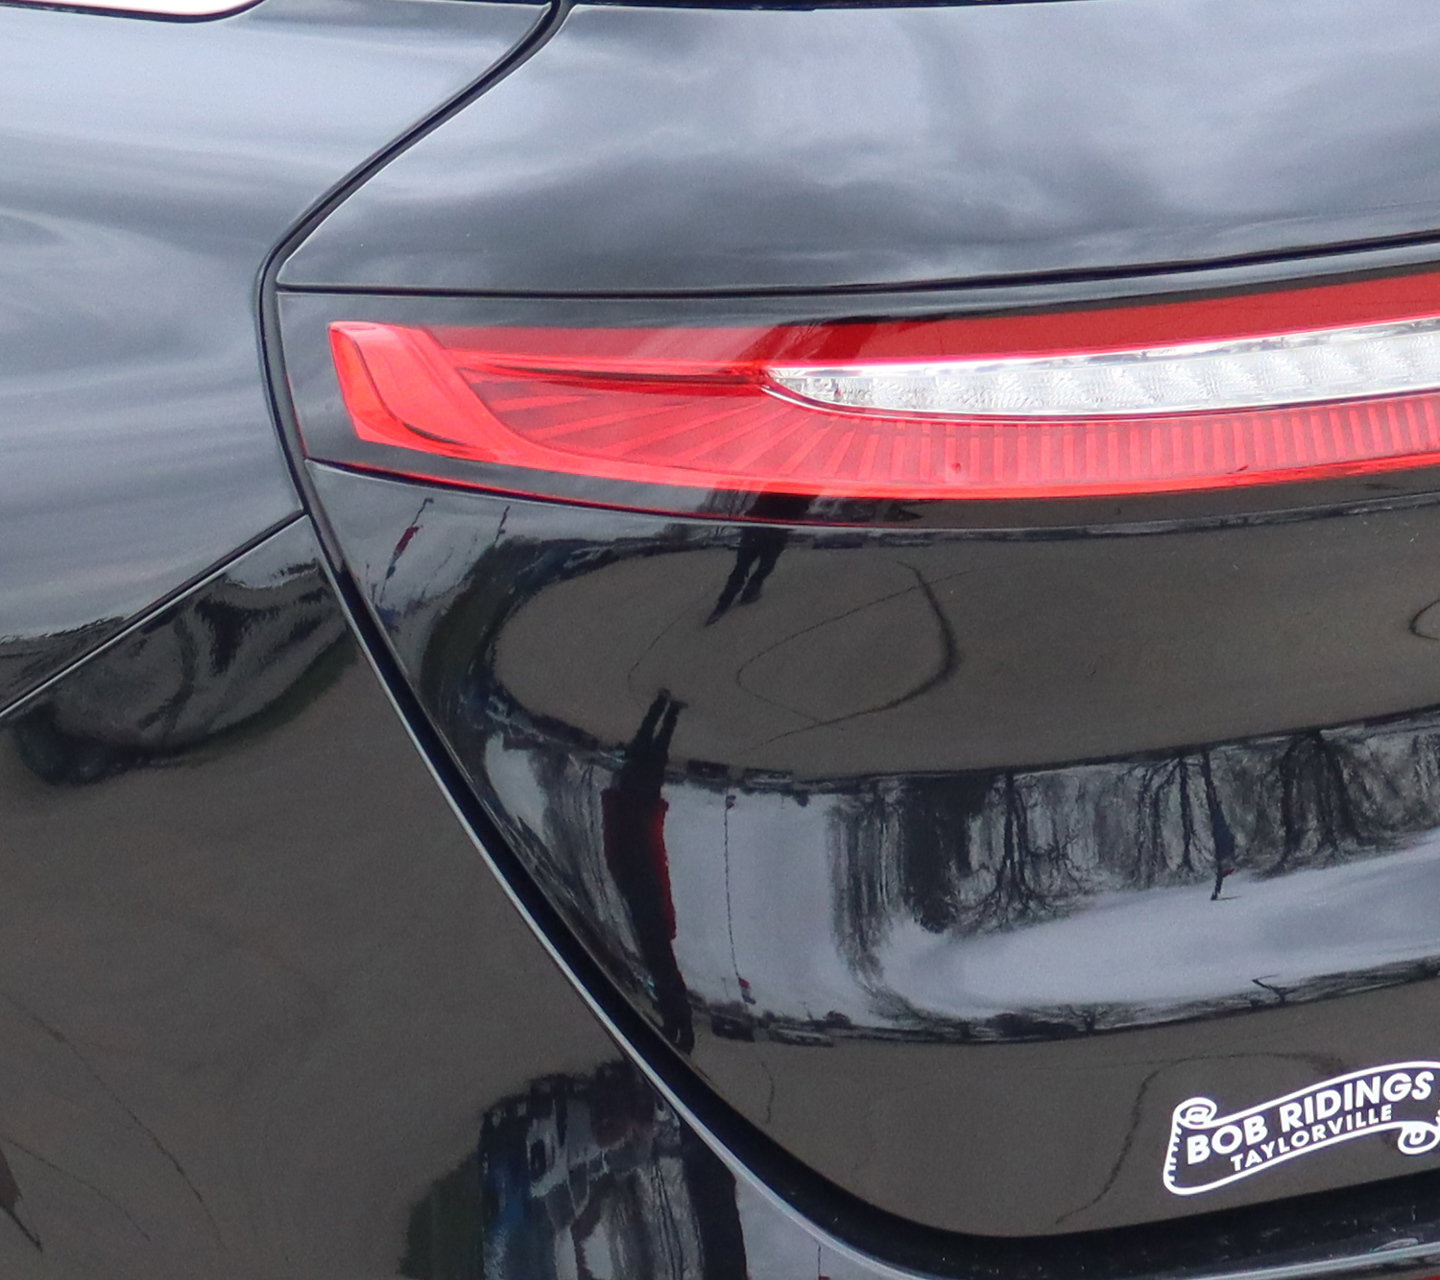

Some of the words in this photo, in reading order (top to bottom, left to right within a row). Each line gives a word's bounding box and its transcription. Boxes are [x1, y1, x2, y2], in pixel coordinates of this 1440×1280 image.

[1186, 1115, 1269, 1166] BOB
[1278, 1070, 1435, 1135] RIDINGS
[1230, 1103, 1393, 1173] TAYLORVILLE
